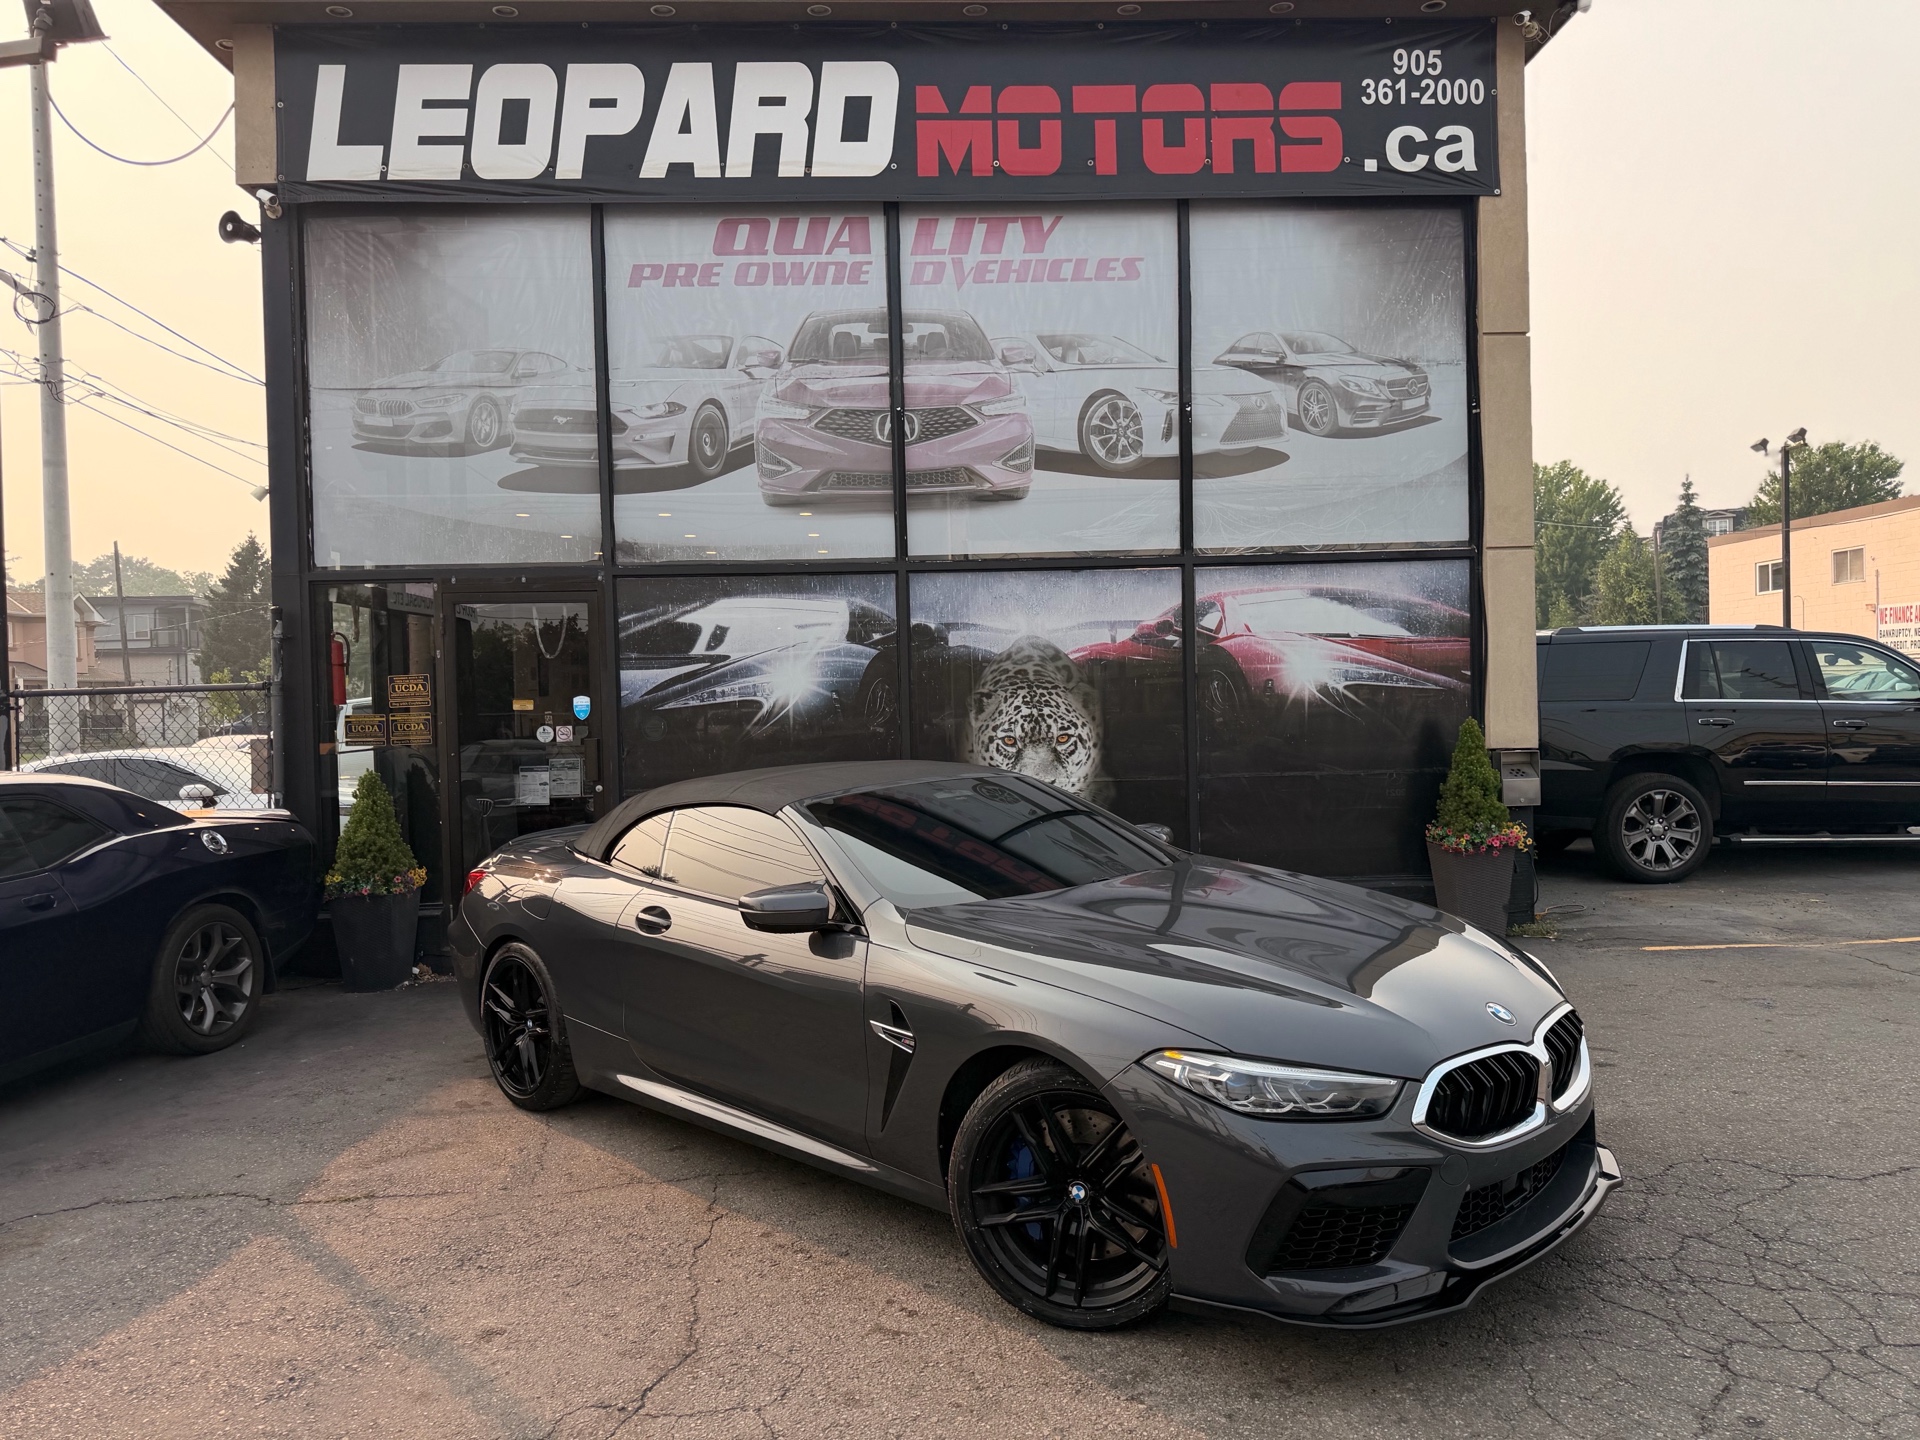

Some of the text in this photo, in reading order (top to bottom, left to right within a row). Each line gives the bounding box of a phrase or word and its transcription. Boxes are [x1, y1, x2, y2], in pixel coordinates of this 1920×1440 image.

[1393, 49, 1442, 76] 905
[1361, 78, 1485, 105] 361-2000
[306, 61, 1343, 181] LEOPARD MOTORS
[1364, 125, 1478, 173] .ca
[628, 263, 723, 288] PRE
[951, 257, 1144, 292] VEHICLES
[1879, 607, 1888, 625] WE
[1889, 605, 1913, 624] FINANCE
[1879, 628, 1913, 639] BANKRUPTCY,
[394, 683, 424, 692] UCDA
[351, 724, 379, 733] UCDA
[397, 723, 425, 731] UCDA
